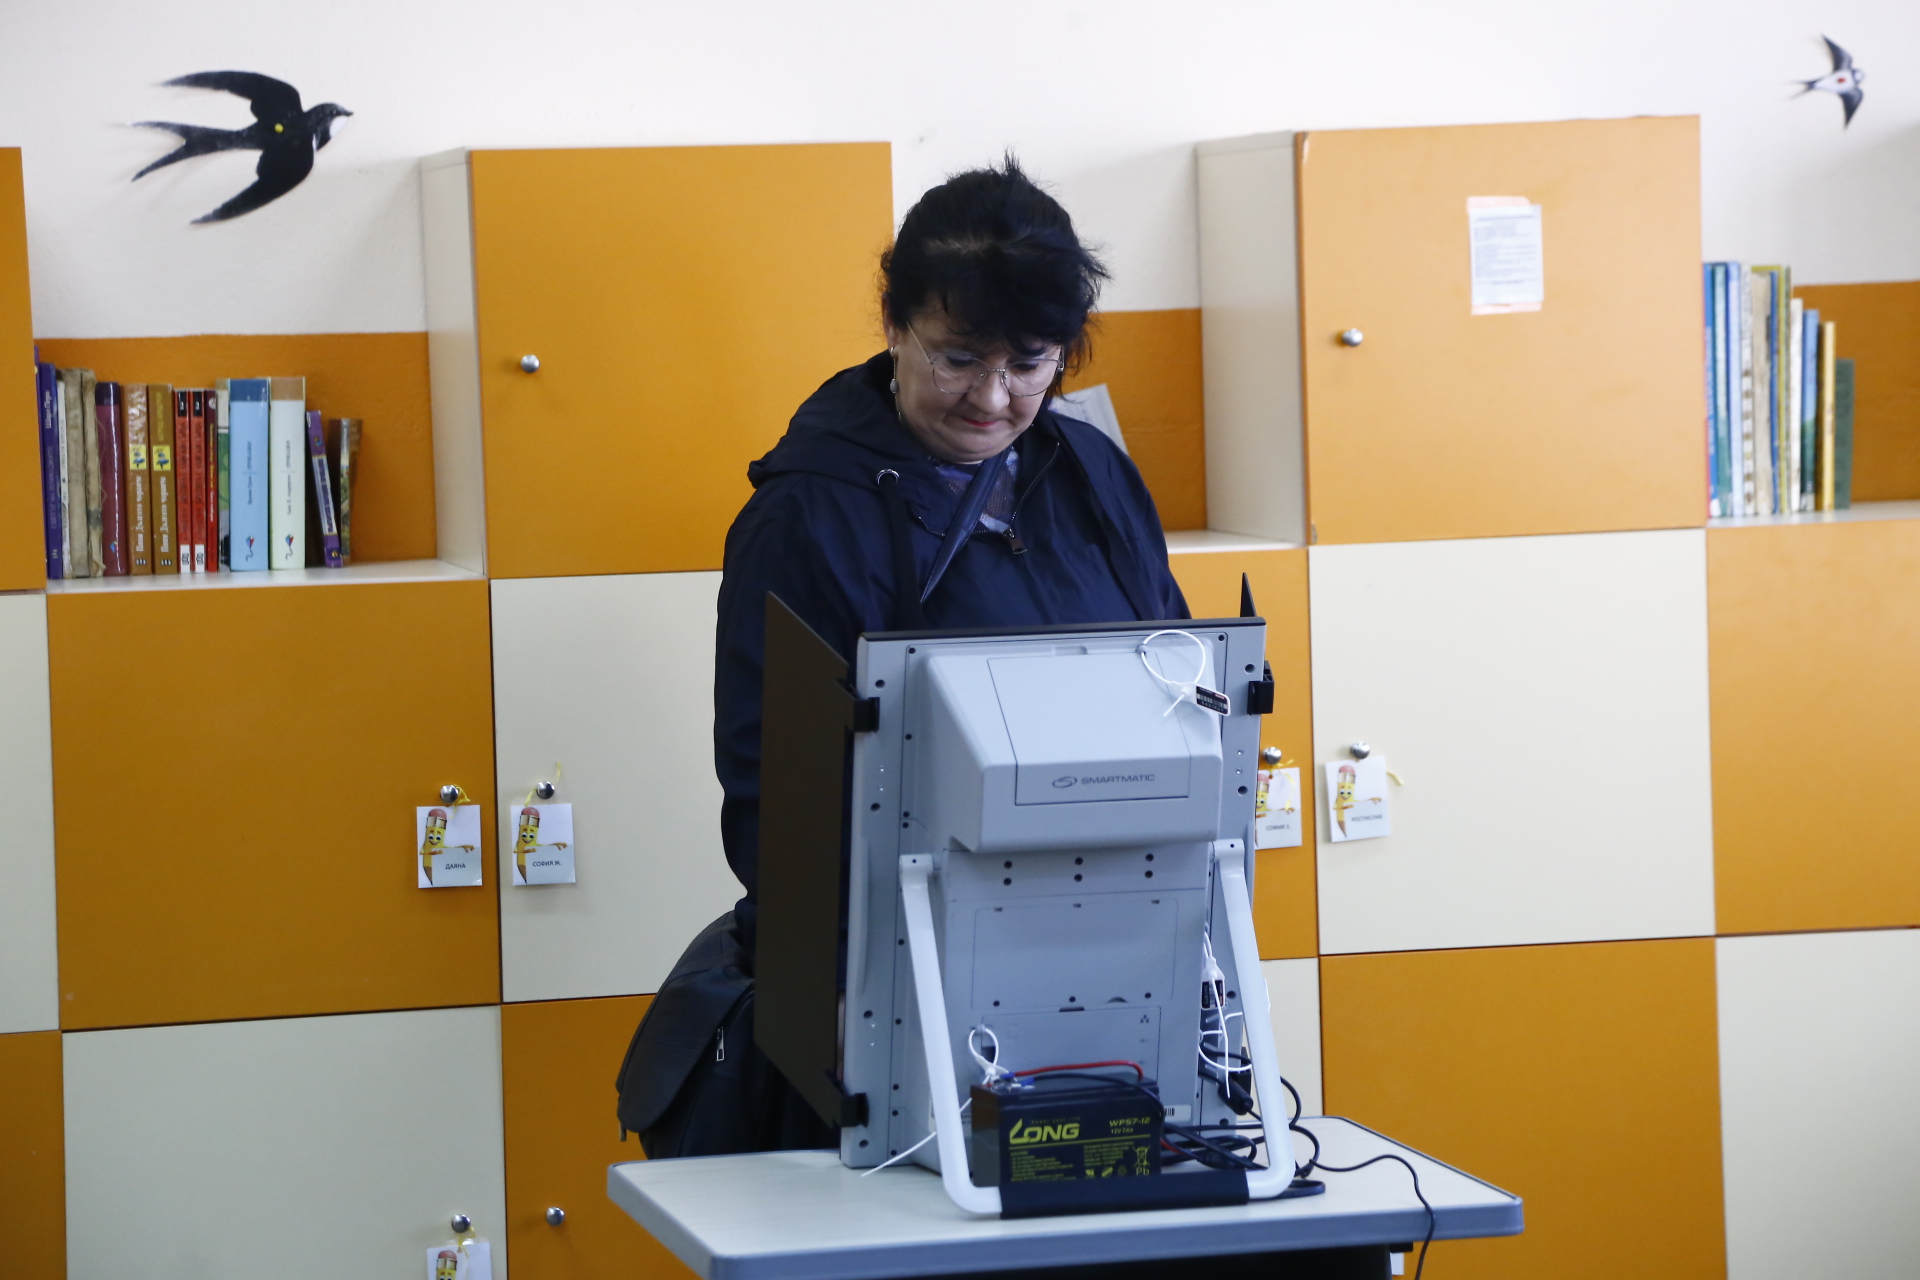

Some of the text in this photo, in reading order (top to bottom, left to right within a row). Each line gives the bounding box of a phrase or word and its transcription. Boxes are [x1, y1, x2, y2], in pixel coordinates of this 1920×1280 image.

[1081, 774, 1155, 785] SMARTMATIC
[445, 862, 466, 870] ДАЯНА
[1109, 1116, 1151, 1127] WPS7-12
[1009, 1118, 1080, 1145] LONG
[1135, 1167, 1150, 1176] Pb
